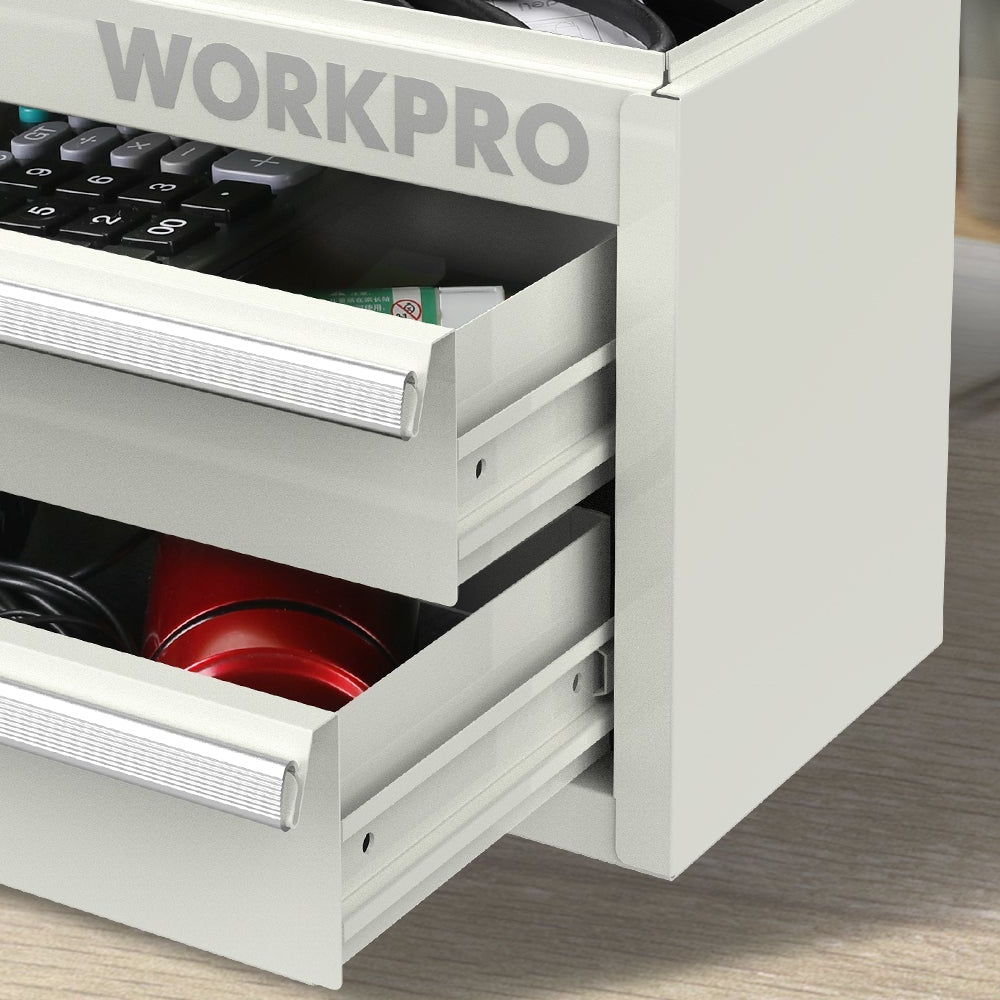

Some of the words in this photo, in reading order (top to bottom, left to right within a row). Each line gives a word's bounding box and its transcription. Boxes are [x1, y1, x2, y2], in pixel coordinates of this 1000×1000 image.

[95, 19, 590, 186] WORKPRO
[23, 126, 57, 141] GT
[25, 167, 53, 177] 9
[87, 175, 114, 185] 6
[149, 183, 177, 192] 3
[27, 206, 56, 216] 5
[92, 214, 122, 225] 2
[146, 218, 188, 236] 00
